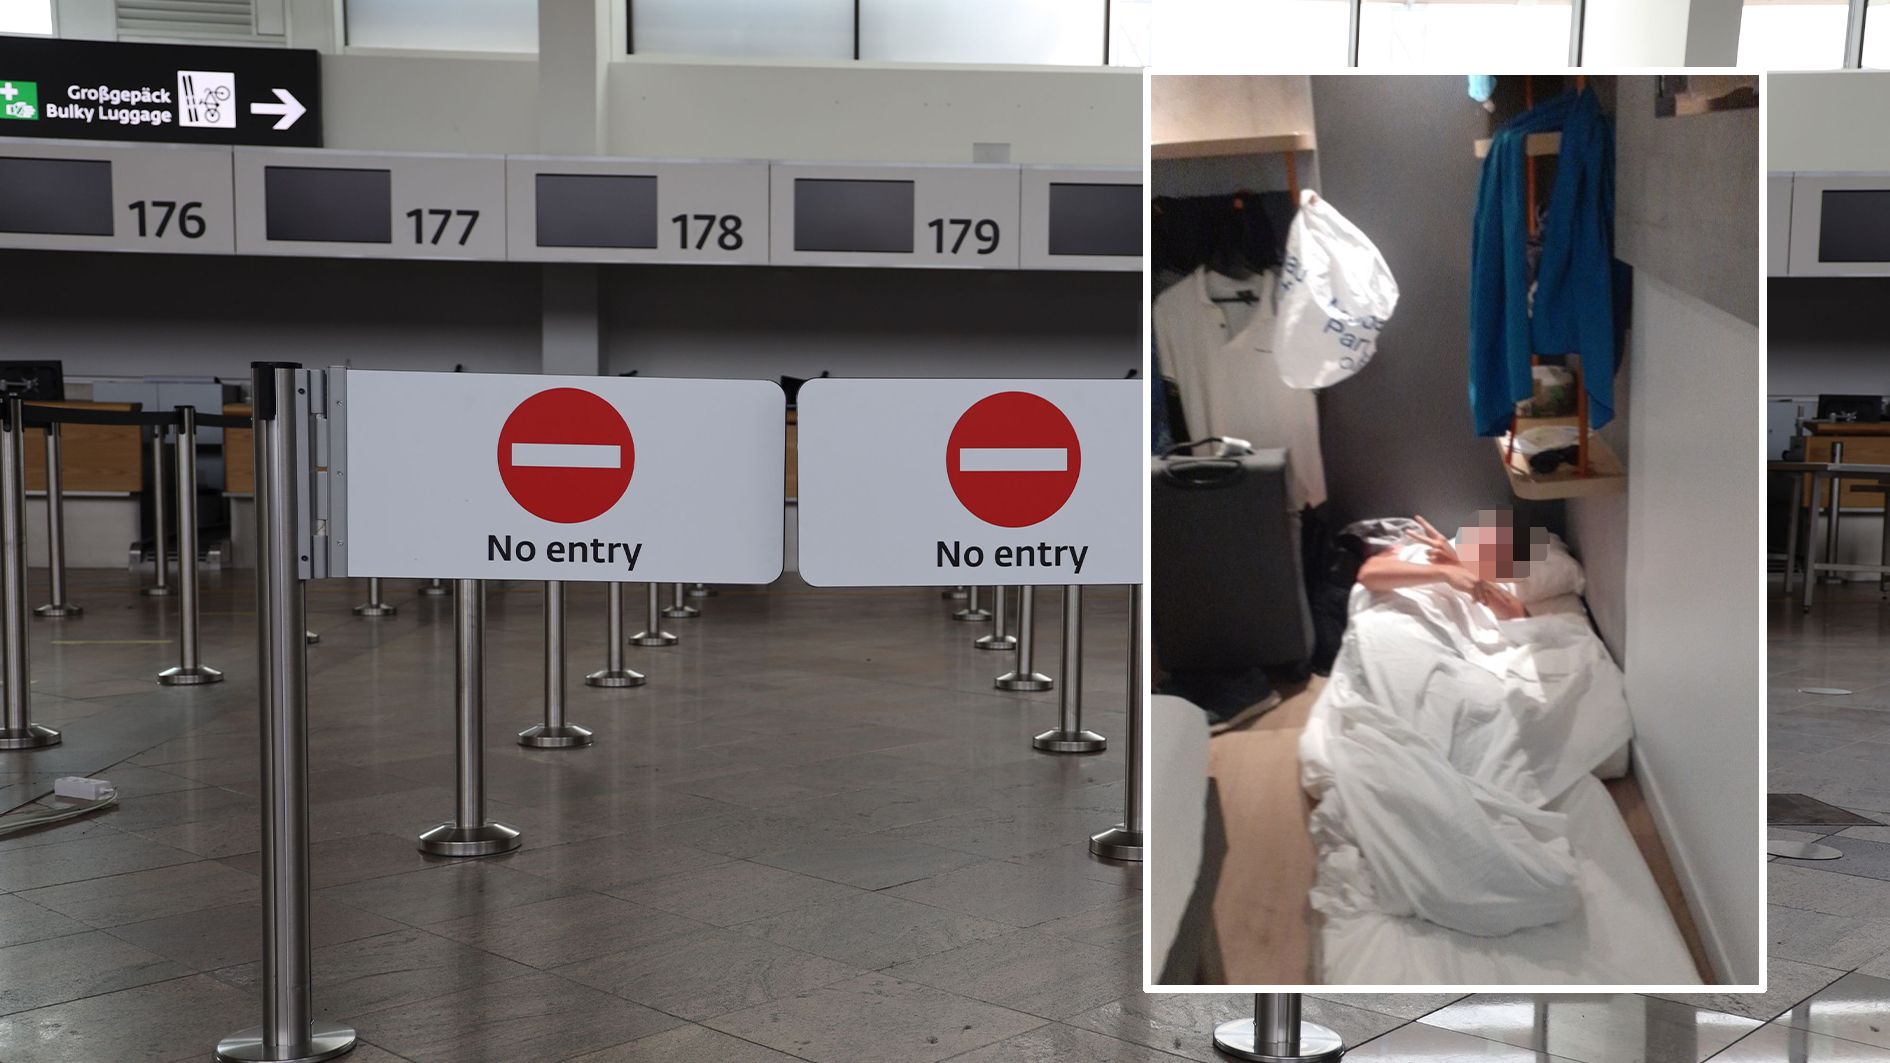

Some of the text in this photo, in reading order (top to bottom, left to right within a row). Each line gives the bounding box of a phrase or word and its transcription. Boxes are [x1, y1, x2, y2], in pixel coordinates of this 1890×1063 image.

[67, 85, 172, 106] Großgepäck
[46, 103, 172, 126] Bulky Luggage
[128, 200, 206, 239] 176
[406, 208, 480, 246] 177
[672, 214, 743, 251] 178
[928, 218, 1000, 255] 179
[487, 534, 643, 572] No entry
[936, 540, 1089, 575] No entry
